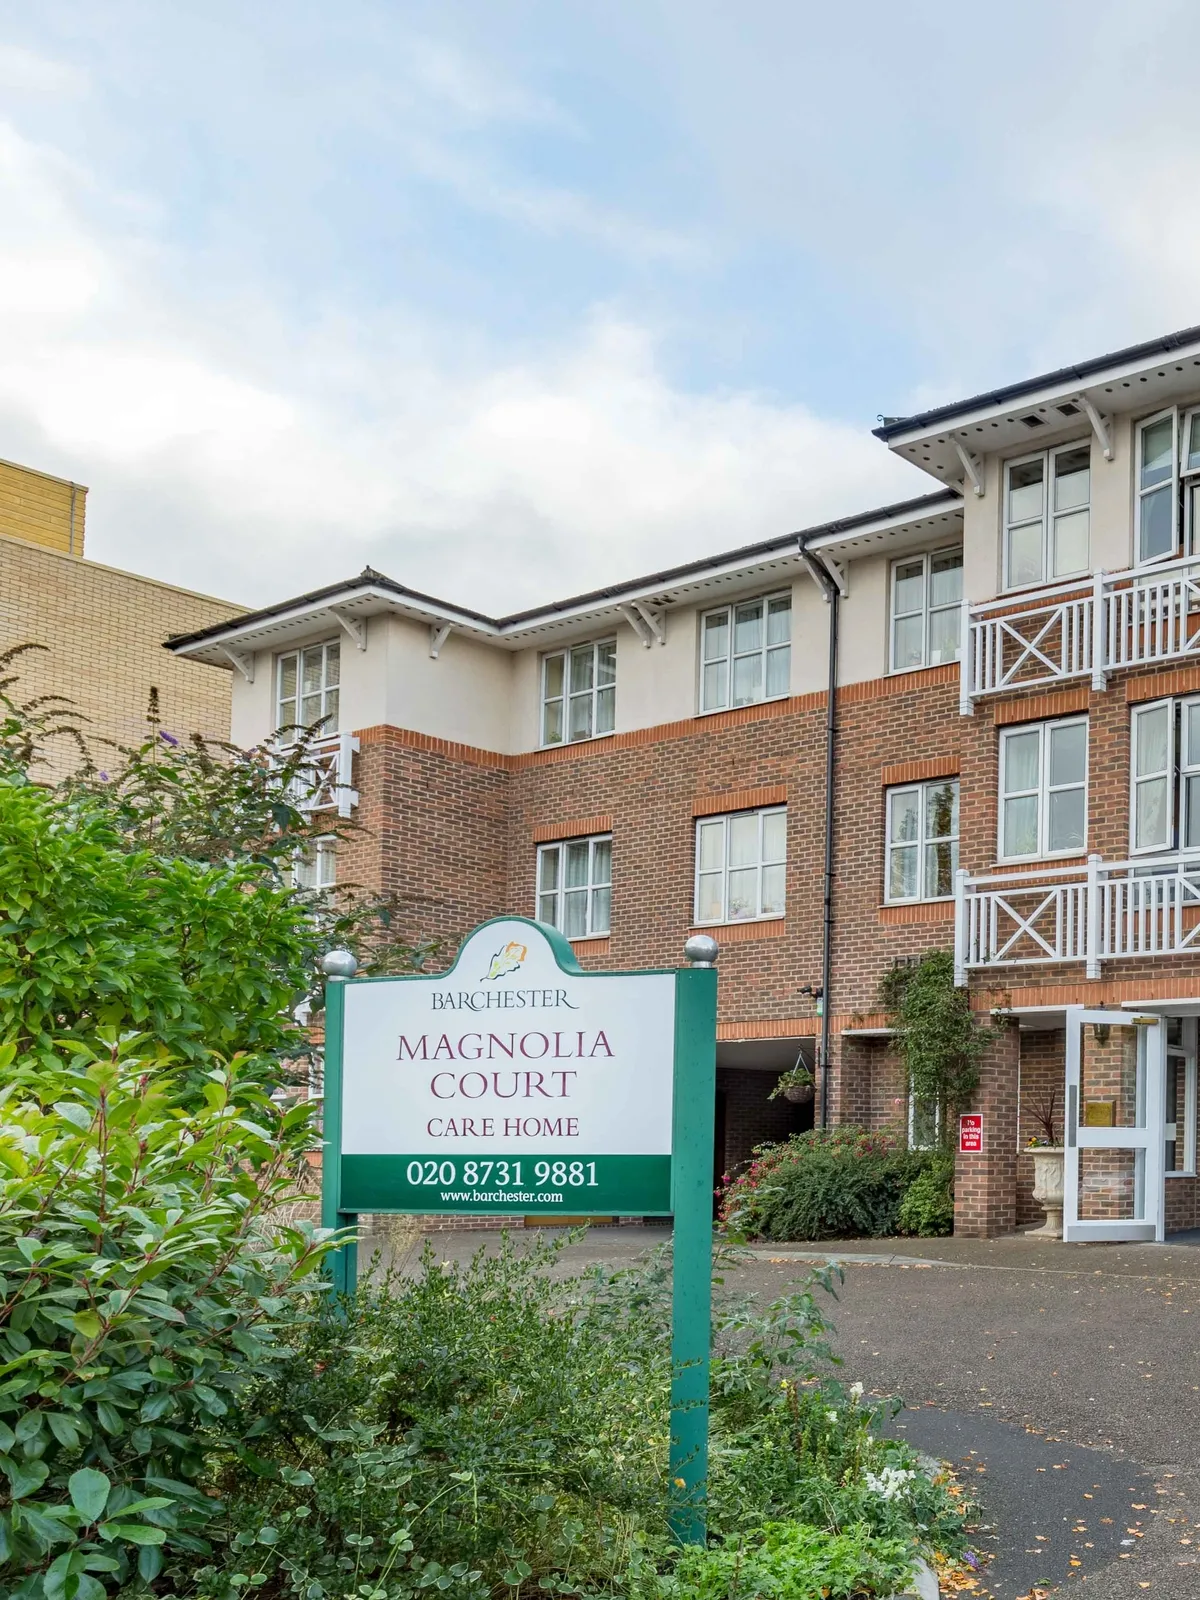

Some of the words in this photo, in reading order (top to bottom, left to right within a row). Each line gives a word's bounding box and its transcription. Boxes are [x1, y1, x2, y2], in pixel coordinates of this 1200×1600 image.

[431, 989, 580, 1011] BARCHESTER
[396, 1030, 616, 1060] MAGNOLIA
[430, 1071, 578, 1099] COURT
[427, 1117, 495, 1137] CARE
[503, 1117, 580, 1137] HOME
[406, 1161, 456, 1186] 020
[463, 1161, 525, 1186] 8731
[534, 1161, 599, 1187] 9881
[440, 1189, 564, 1203] www.barchester.com
